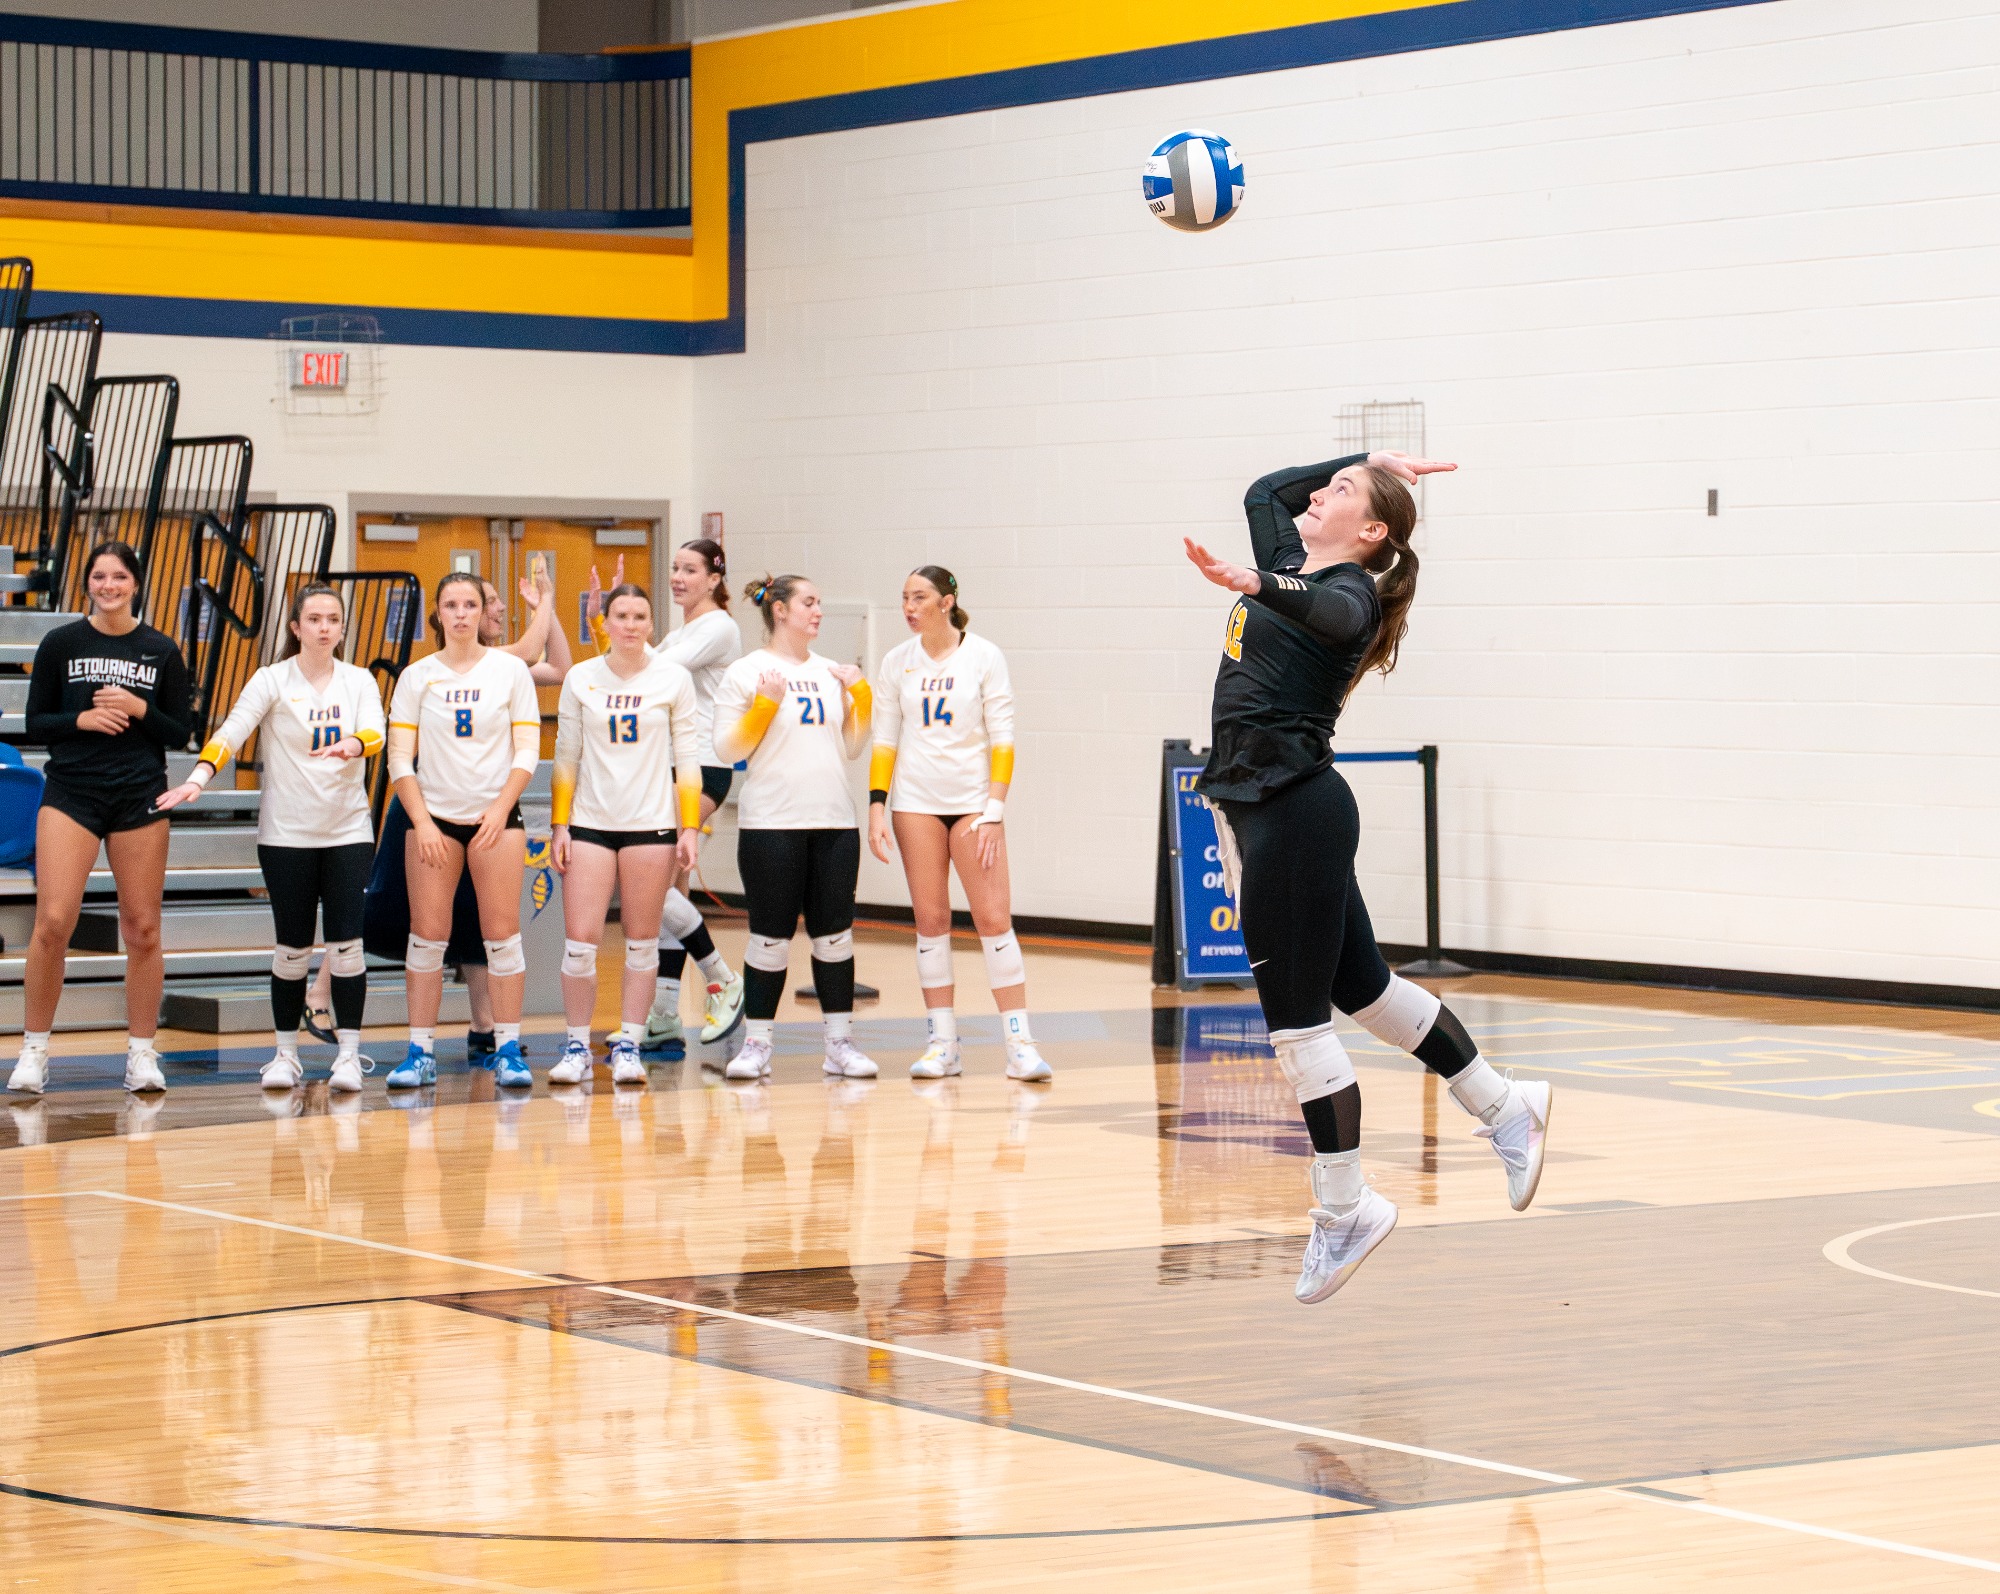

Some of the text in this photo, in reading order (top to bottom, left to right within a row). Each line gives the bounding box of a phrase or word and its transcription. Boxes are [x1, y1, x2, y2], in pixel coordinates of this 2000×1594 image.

[303, 352, 343, 386] EXIT
[68, 657, 157, 684] LETOURNEAU
[85, 674, 136, 688] VOLLEYBALL
[921, 676, 954, 692] LETU
[445, 689, 480, 703] LETU
[788, 680, 819, 692] LETU
[606, 694, 642, 709] LETU
[797, 696, 825, 726] 21
[922, 697, 954, 727] 14
[454, 708, 473, 738] 8
[608, 713, 638, 744] 13
